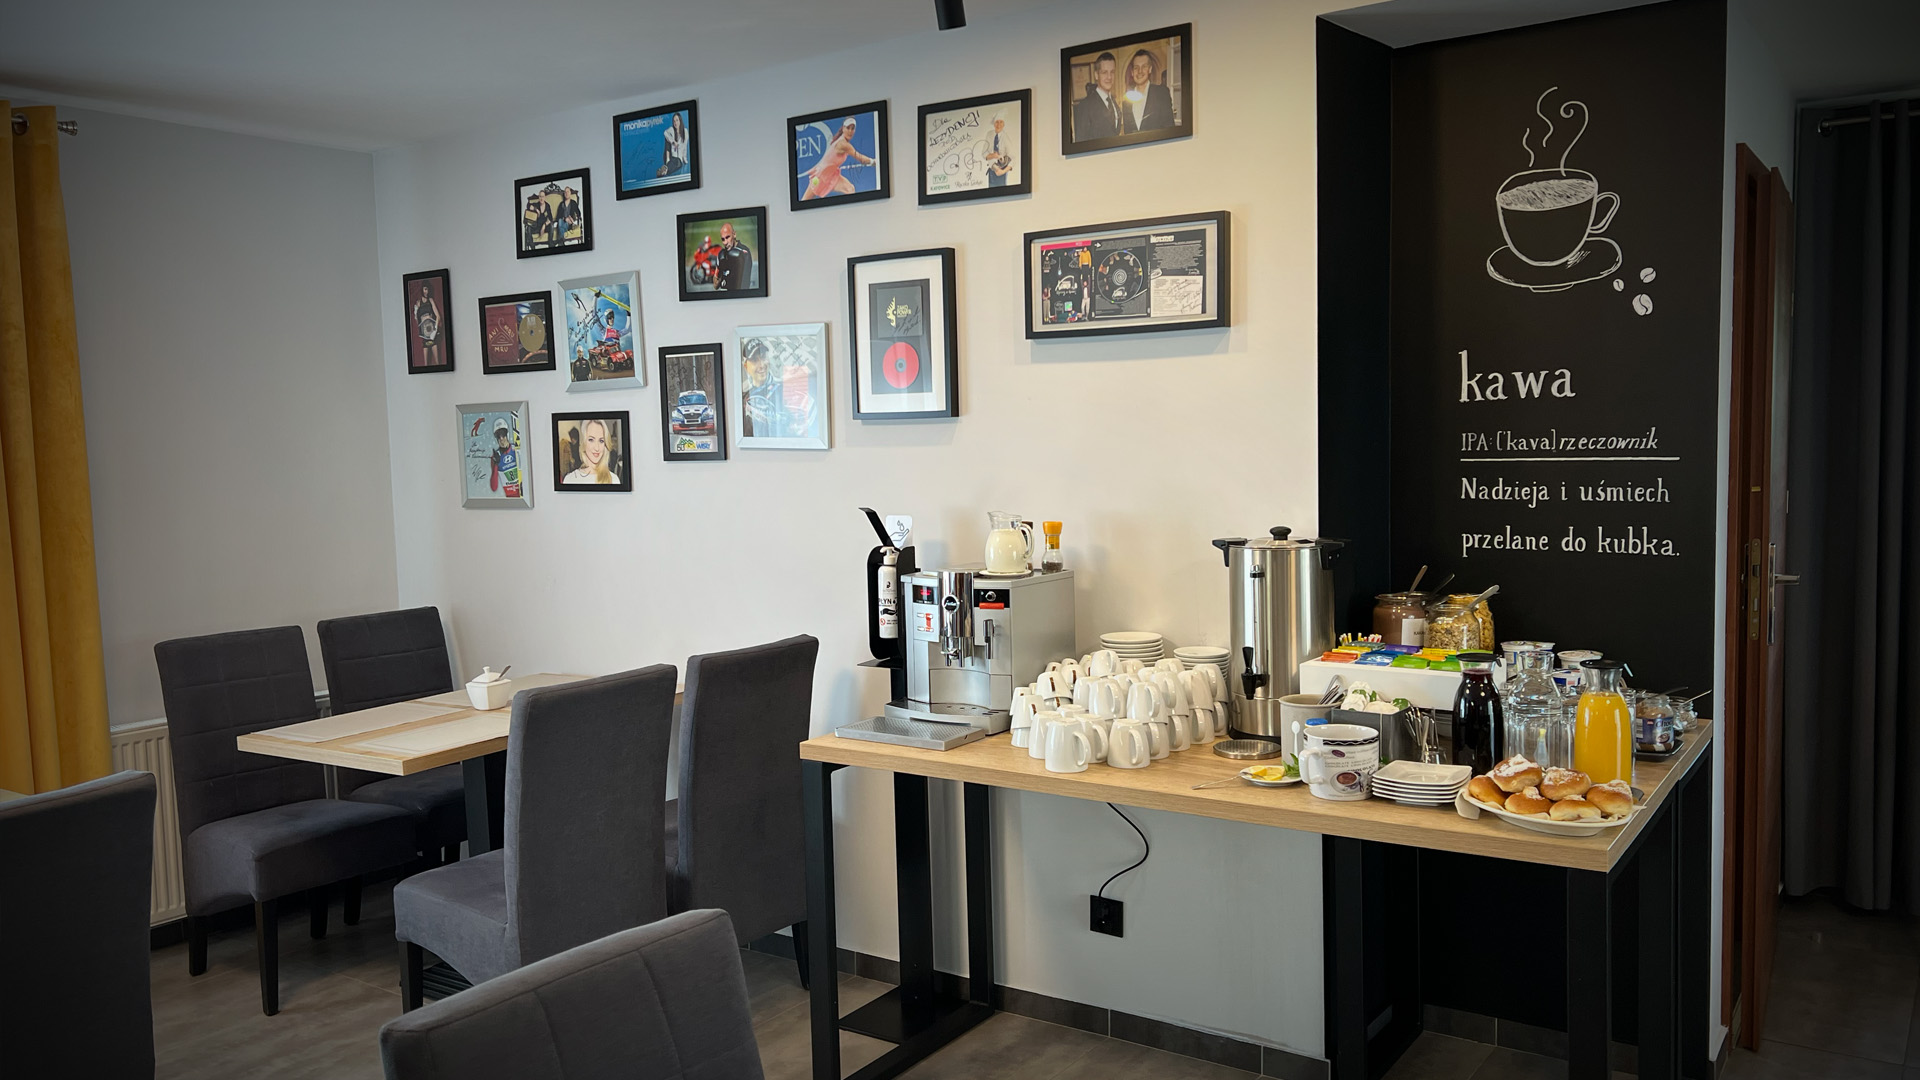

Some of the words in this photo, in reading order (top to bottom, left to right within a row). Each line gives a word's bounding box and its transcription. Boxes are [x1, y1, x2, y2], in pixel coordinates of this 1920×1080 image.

[1459, 350, 1576, 402] kawa
[1559, 427, 1658, 450] rzeczownik
[1460, 477, 1550, 508] Nadzieja
[1560, 481, 1568, 501] i
[1578, 478, 1670, 502] uśmiech
[1461, 525, 1549, 557] przelane
[1561, 526, 1587, 552] do
[1597, 525, 1680, 557] kubka.
